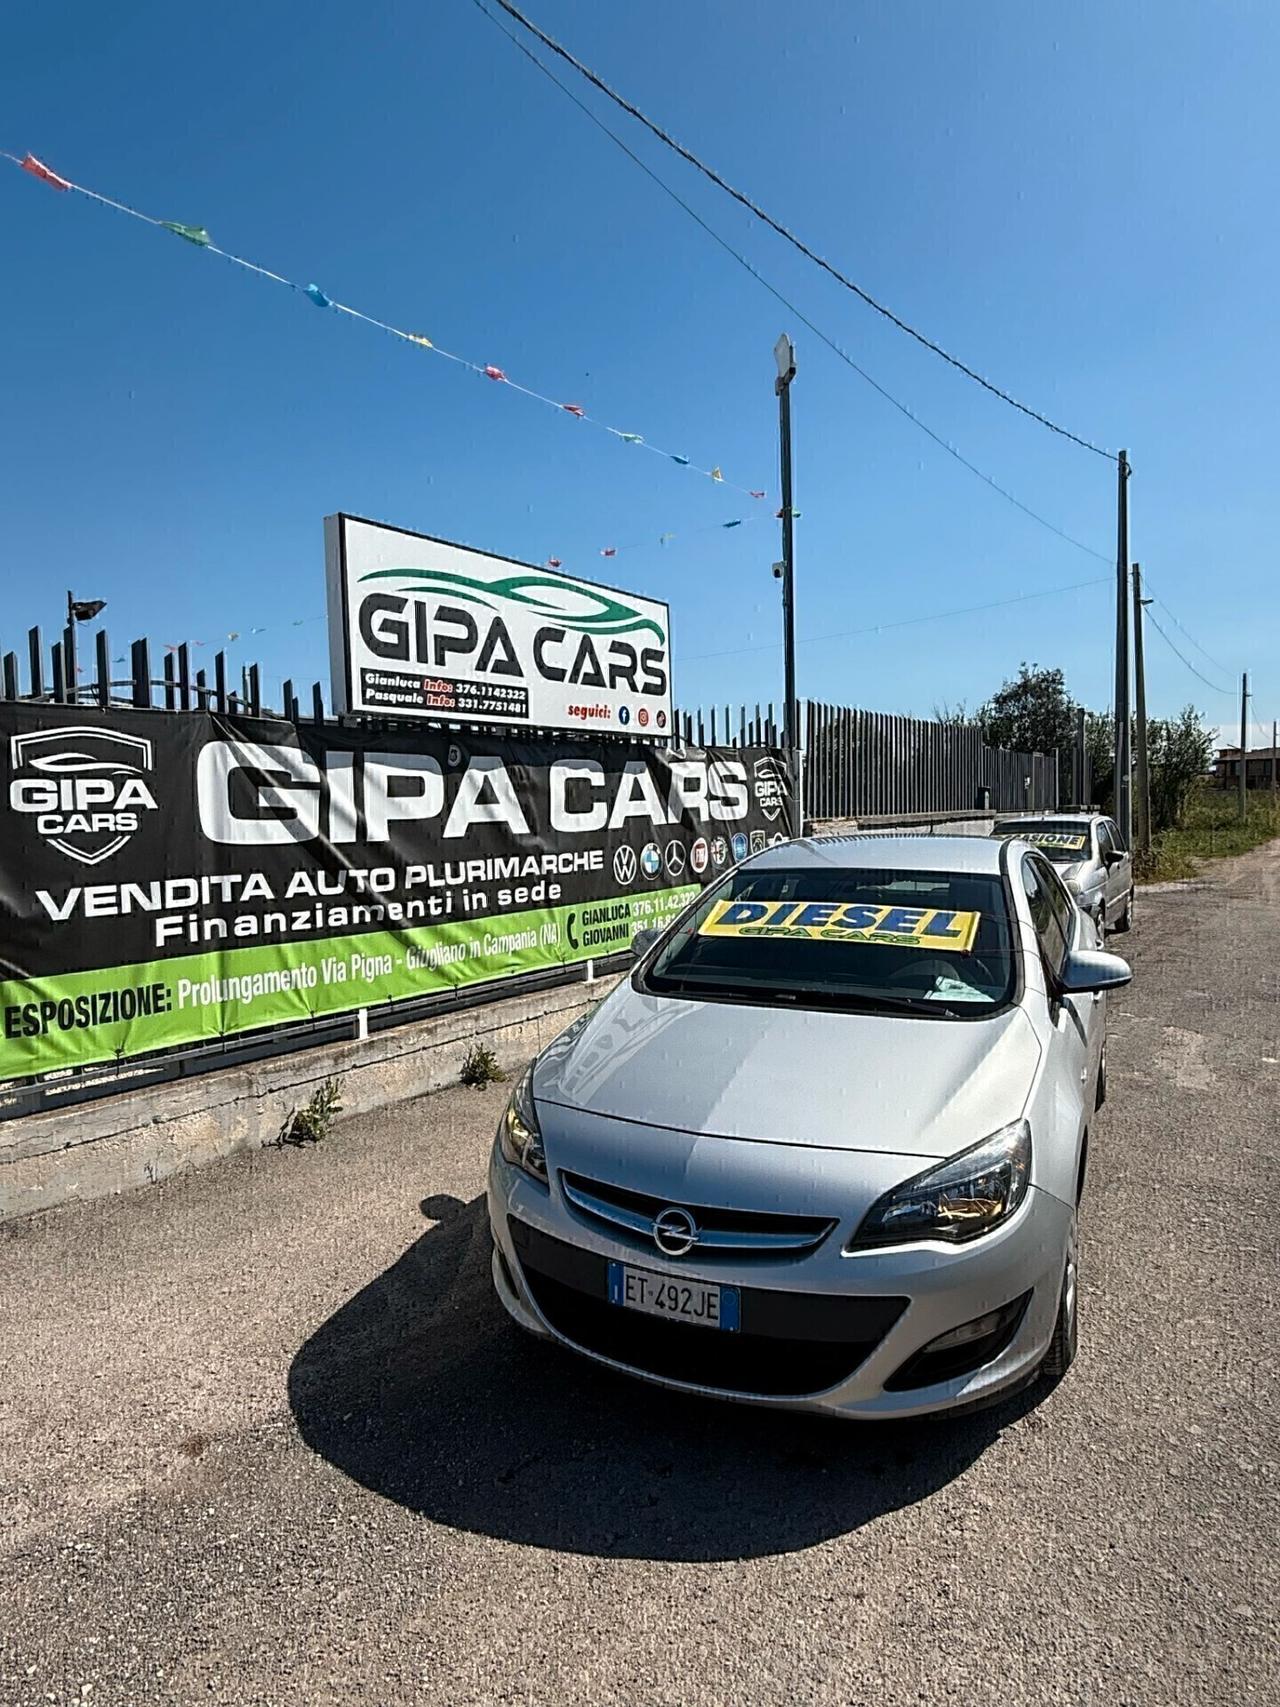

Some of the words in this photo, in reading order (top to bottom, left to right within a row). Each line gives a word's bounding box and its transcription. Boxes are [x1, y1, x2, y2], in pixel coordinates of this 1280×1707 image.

[359, 592, 524, 677] GIPA
[533, 626, 666, 697] CARS
[365, 672, 421, 689] Gianluca
[423, 678, 453, 693] Info:
[456, 683, 526, 700] 376.1142322
[366, 688, 424, 704] Pasquale
[426, 693, 456, 708] Info:
[458, 698, 527, 713] 331.7751481
[568, 704, 611, 720] seguici:
[10, 779, 158, 812] GIPA
[197, 741, 530, 845] GIPA
[550, 759, 748, 832] CARS
[37, 812, 138, 835] CARS
[36, 873, 274, 921] VENDITA
[285, 867, 395, 898] AUTO
[405, 849, 604, 889] PLURIMARCHE
[155, 891, 452, 947] Finanziamenti
[463, 889, 487, 911] in
[498, 880, 562, 906] sede
[582, 903, 631, 926] GIANLUCA
[715, 903, 962, 937] DIESEL
[583, 923, 629, 947] GIOVANNI
[739, 926, 812, 938] GIPA
[820, 928, 921, 945] CARS
[5, 982, 172, 1039] ESPOSIZIONE:
[177, 958, 317, 1009] Prolungamento
[321, 955, 347, 984] Via
[351, 953, 392, 983] Pigna
[406, 942, 466, 972] Giugliano
[469, 936, 481, 957] in
[483, 929, 536, 956] Campania
[539, 924, 561, 947] (NA)
